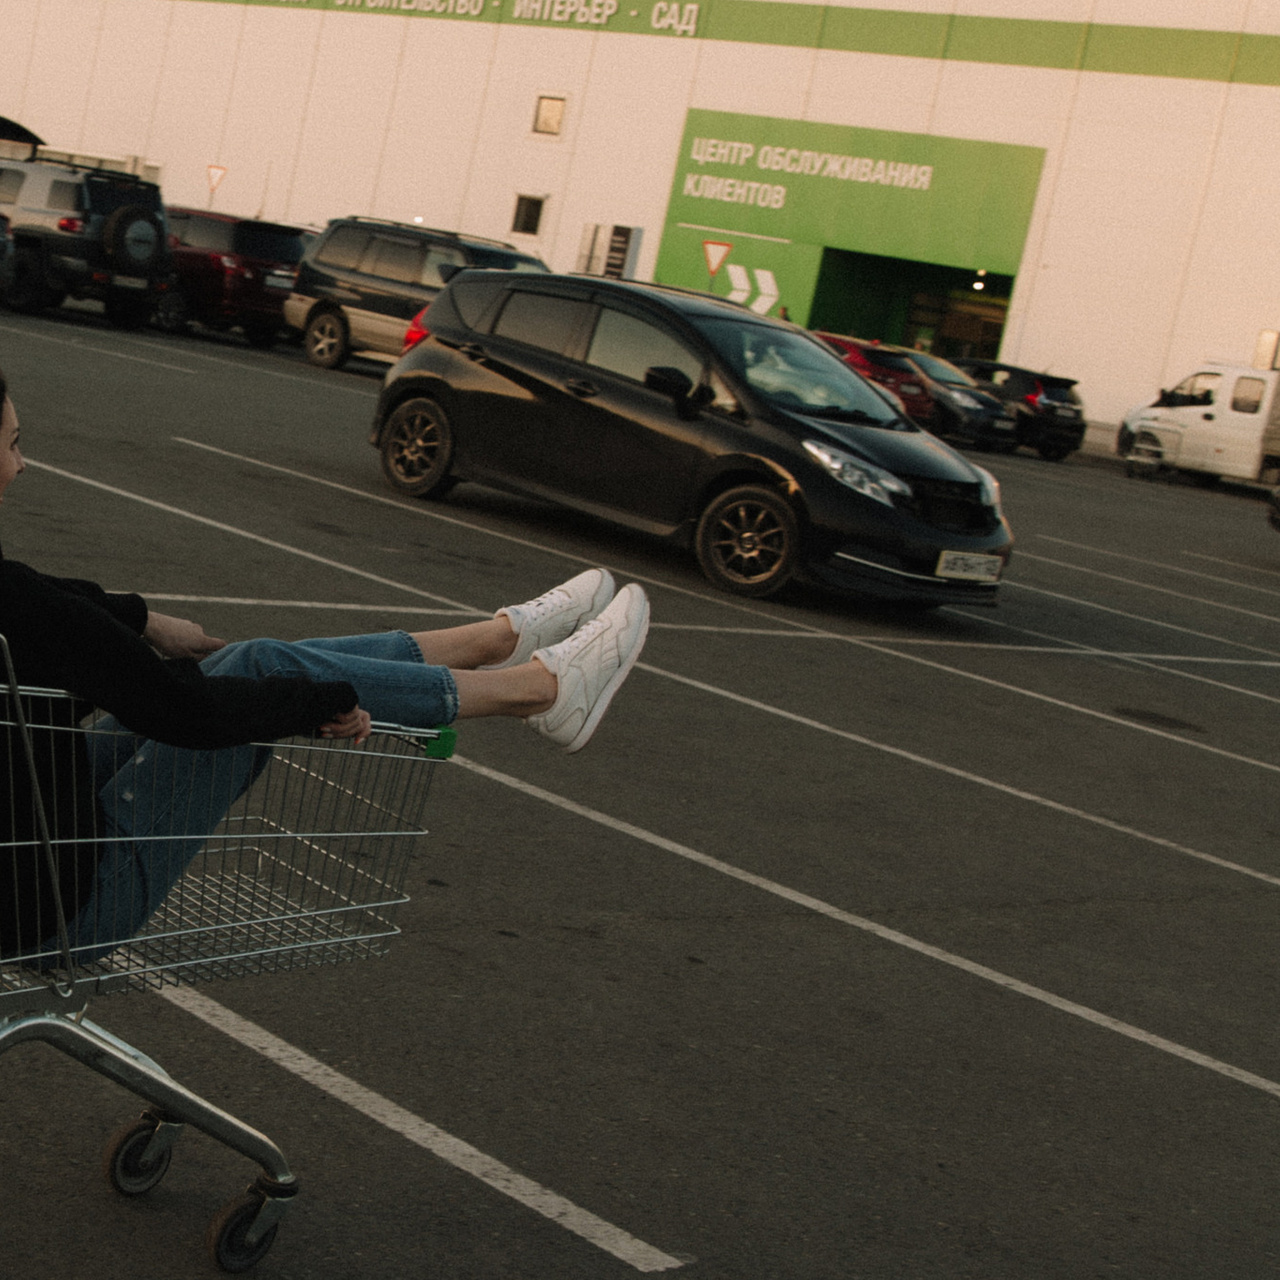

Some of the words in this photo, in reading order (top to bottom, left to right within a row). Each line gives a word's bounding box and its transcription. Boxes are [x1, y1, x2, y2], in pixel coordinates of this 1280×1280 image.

[651, 1, 700, 36] САД
[691, 137, 755, 166] ЦЕНТР
[757, 145, 934, 191] ОБСЛУЖИВАНИЯ
[683, 173, 787, 209] КЛИЕНТОВ
